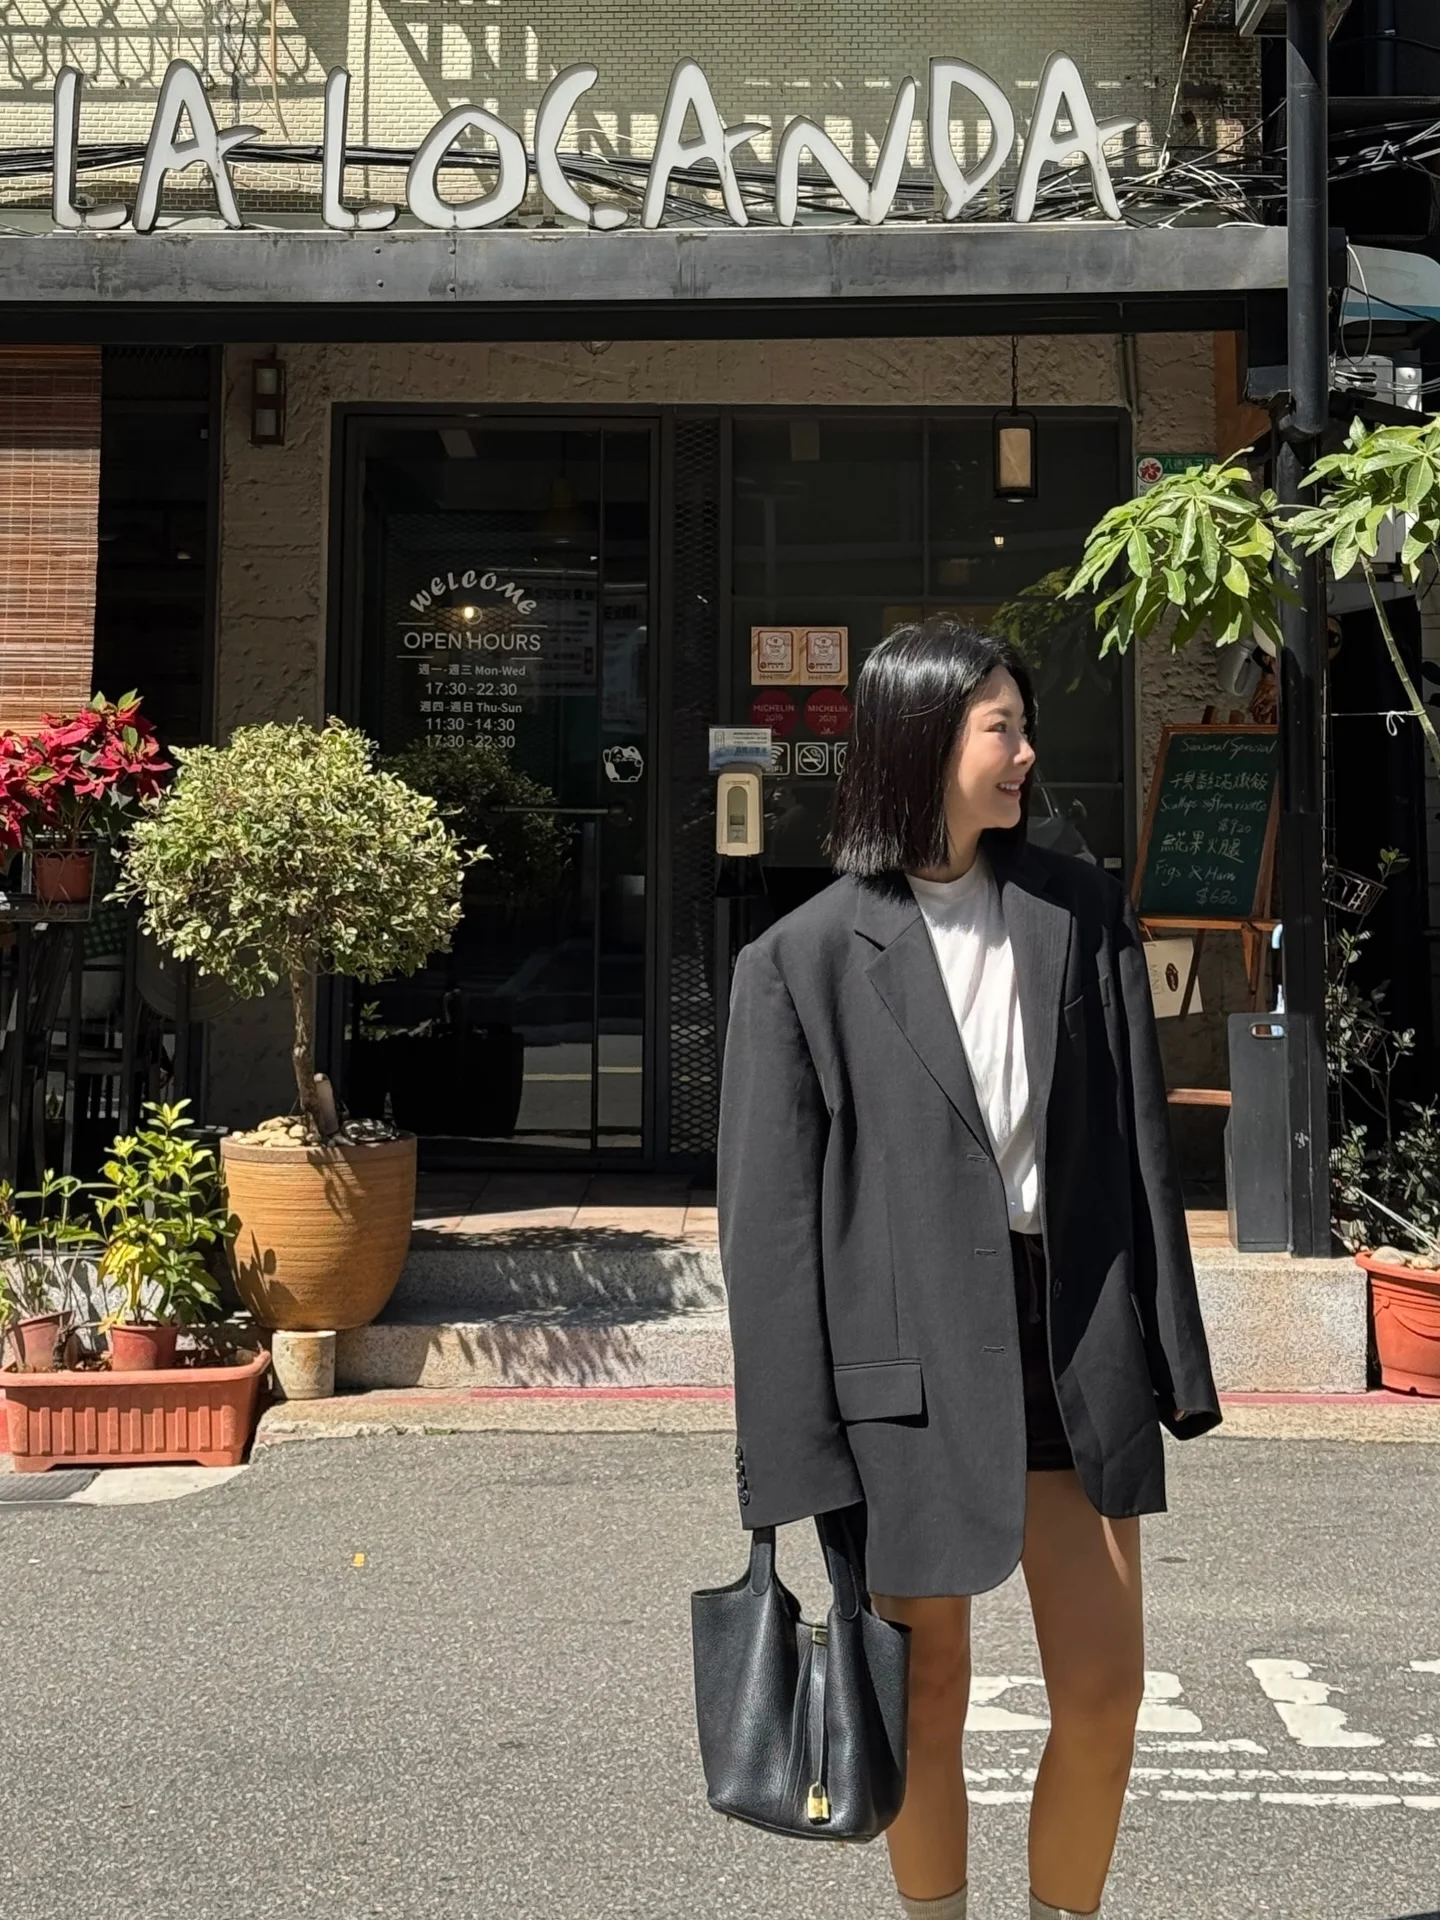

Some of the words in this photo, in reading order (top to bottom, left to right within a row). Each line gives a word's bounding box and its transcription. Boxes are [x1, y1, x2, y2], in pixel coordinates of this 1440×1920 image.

[52, 57, 267, 232] LA
[403, 632, 462, 650] OPEN
[468, 633, 541, 651] HOURS
[475, 665, 526, 676] Mon-Wed
[476, 702, 522, 713] Thu-Sun
[753, 704, 795, 713] MICHELIN
[807, 704, 848, 713] MICHELIN
[1155, 859, 1182, 887] Figs
